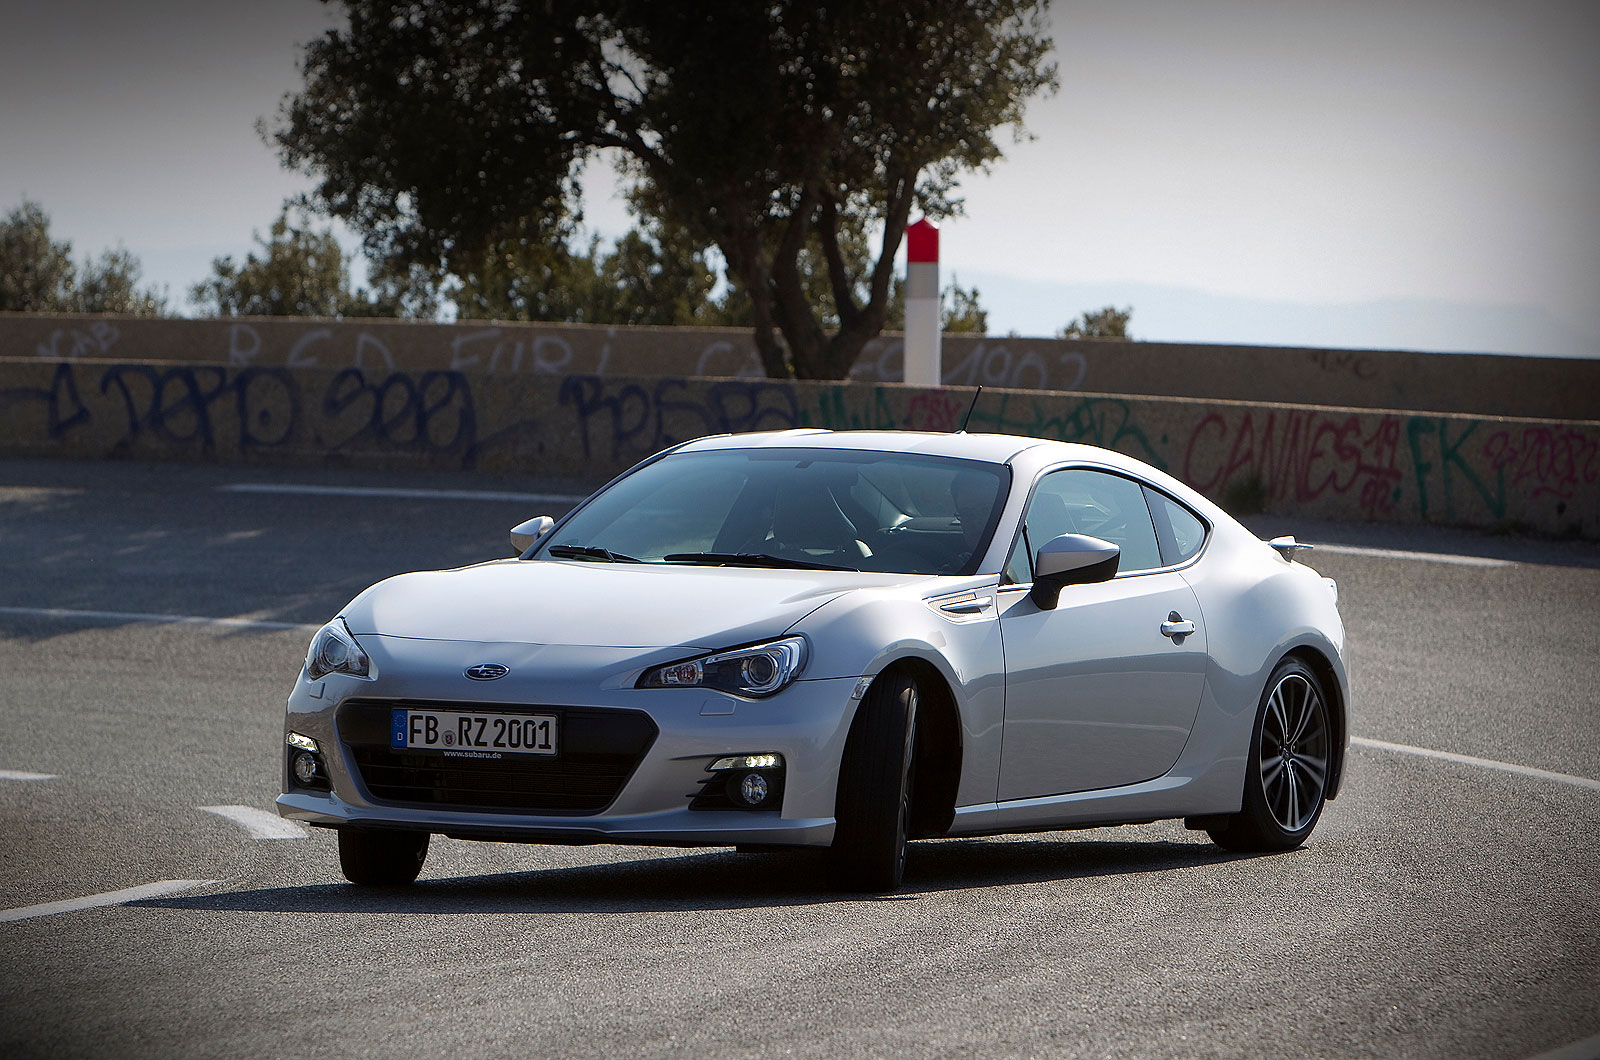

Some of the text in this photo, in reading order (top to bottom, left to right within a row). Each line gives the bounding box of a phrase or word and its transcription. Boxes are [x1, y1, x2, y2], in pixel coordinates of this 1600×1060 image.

[1183, 409, 1362, 504] CANNES
[409, 714, 439, 745] FB
[458, 716, 488, 747] RZ
[493, 718, 552, 750] 2001
[443, 750, 502, 760] www.subaru.de
